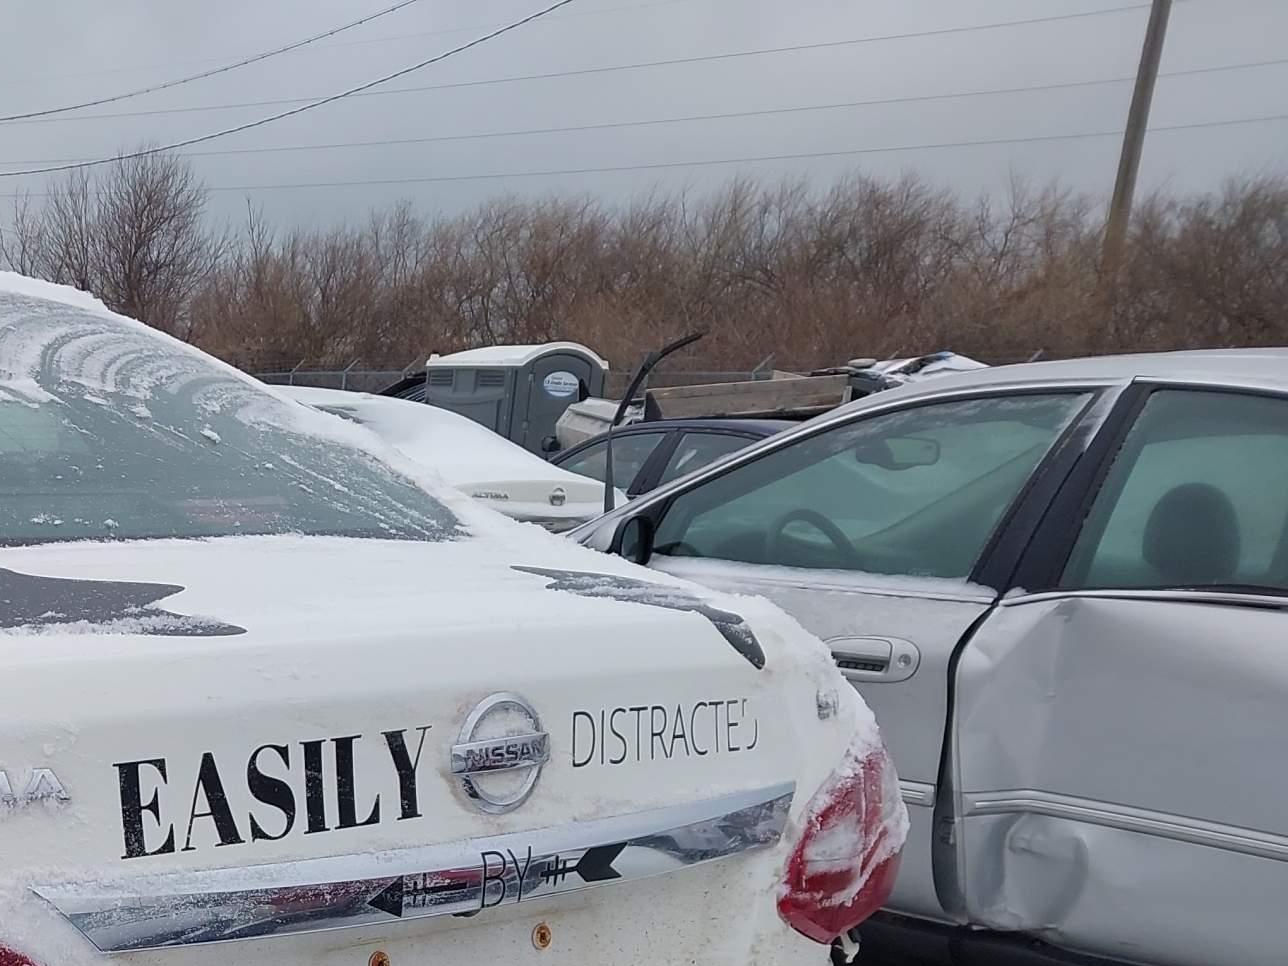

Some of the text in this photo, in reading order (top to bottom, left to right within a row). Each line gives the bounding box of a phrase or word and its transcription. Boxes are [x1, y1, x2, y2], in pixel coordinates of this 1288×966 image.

[466, 740, 546, 766] NISSAN
[113, 725, 432, 860] EASILY
[481, 846, 532, 909] BY
